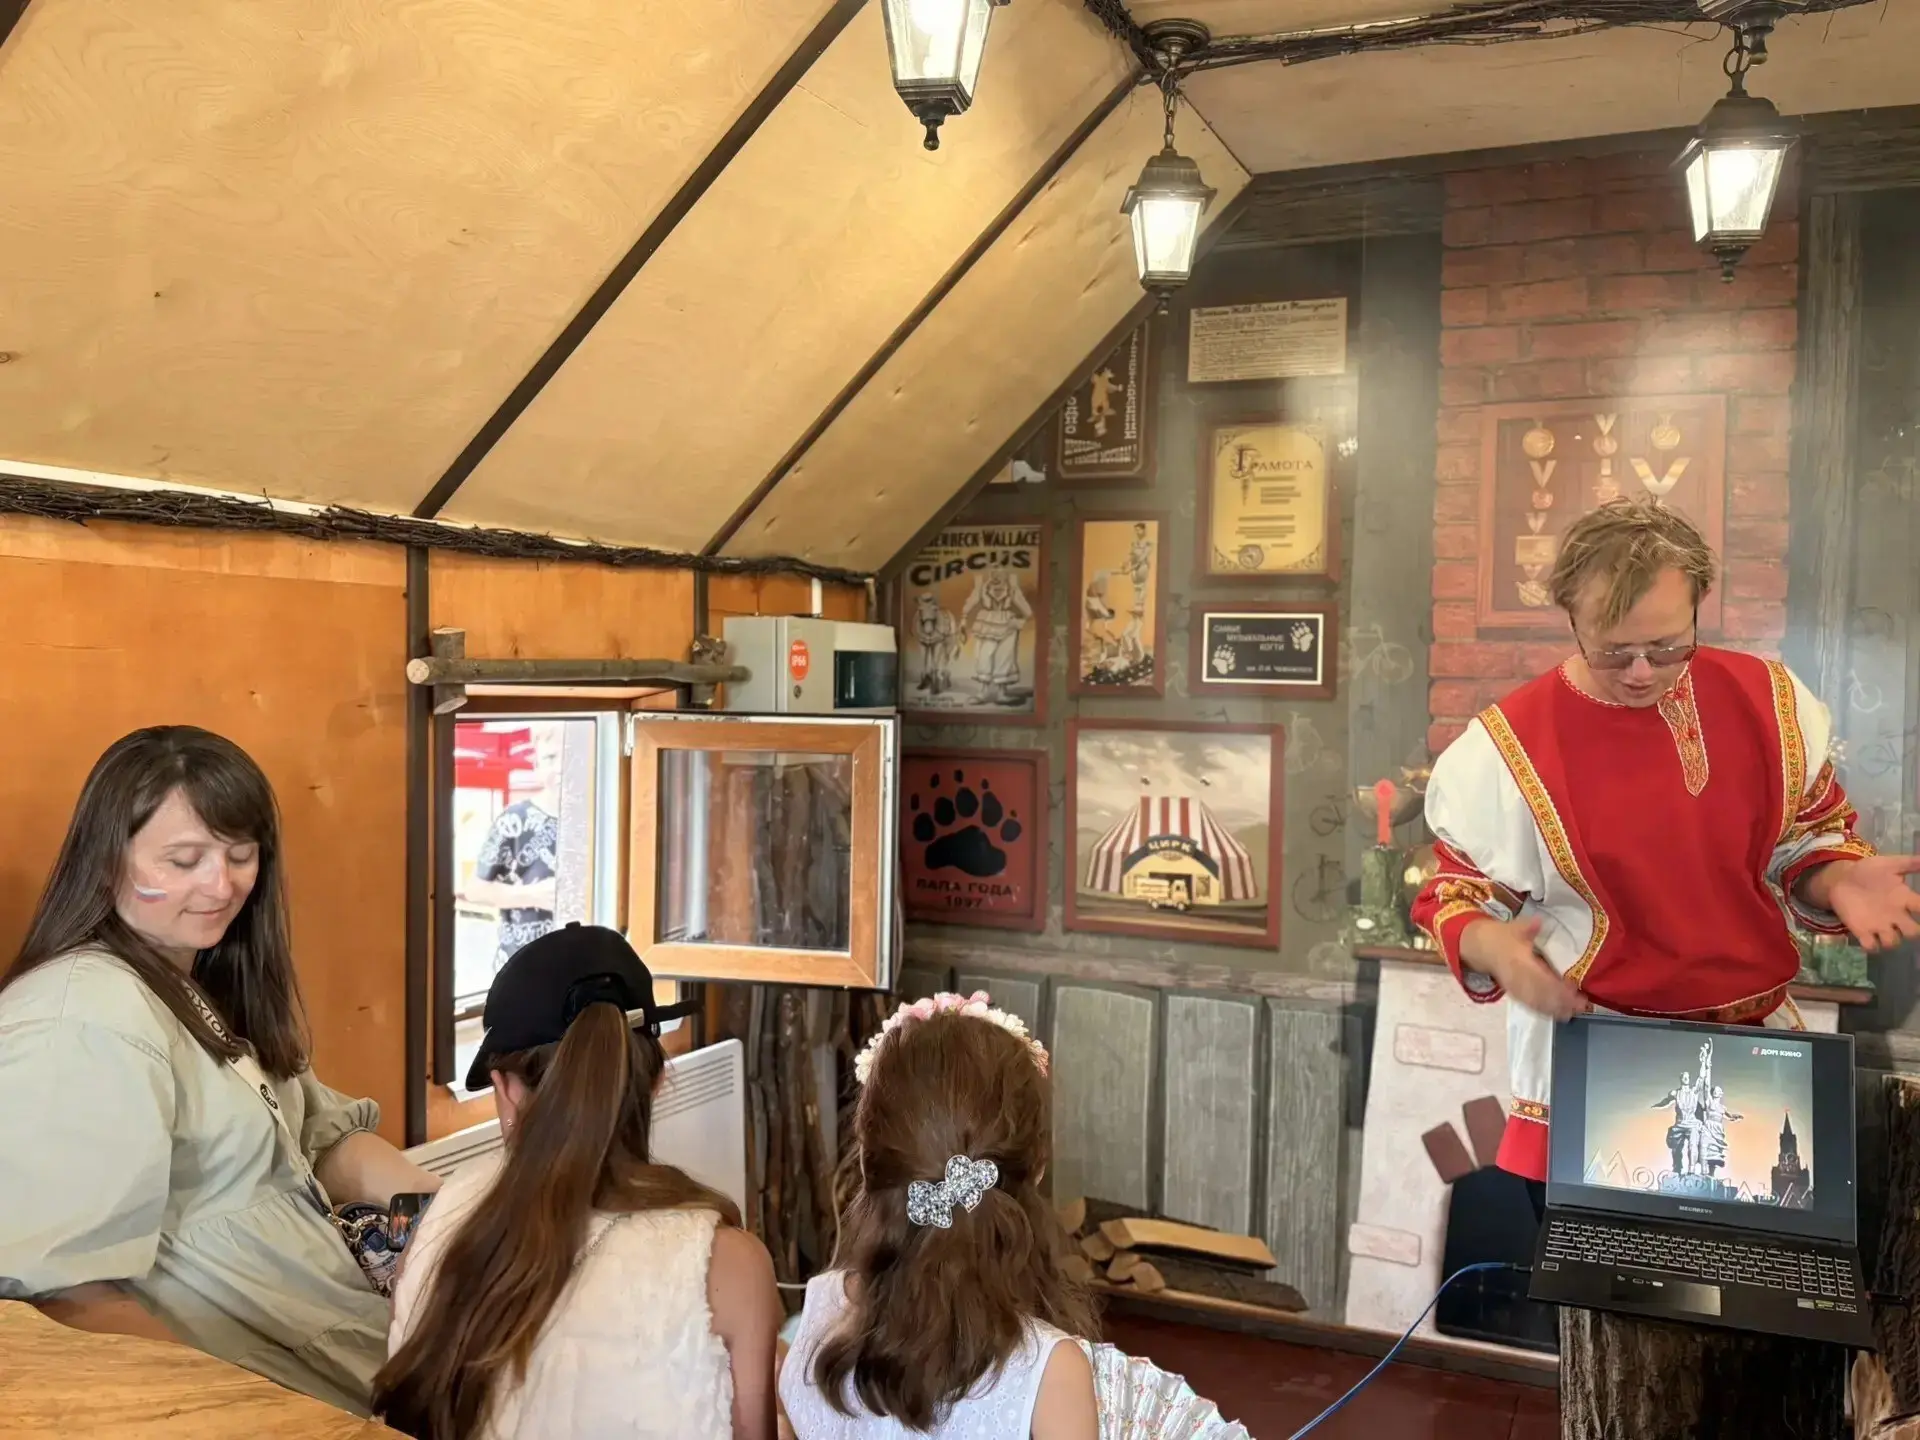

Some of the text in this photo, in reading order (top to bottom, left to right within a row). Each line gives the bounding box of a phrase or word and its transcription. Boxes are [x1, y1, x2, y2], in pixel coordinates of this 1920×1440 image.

[910, 549, 1031, 588] CIRCUS
[1148, 840, 1191, 852] ЦИРК
[968, 882, 1013, 896] ГОДА
[1780, 1050, 1802, 1058] КИНО
